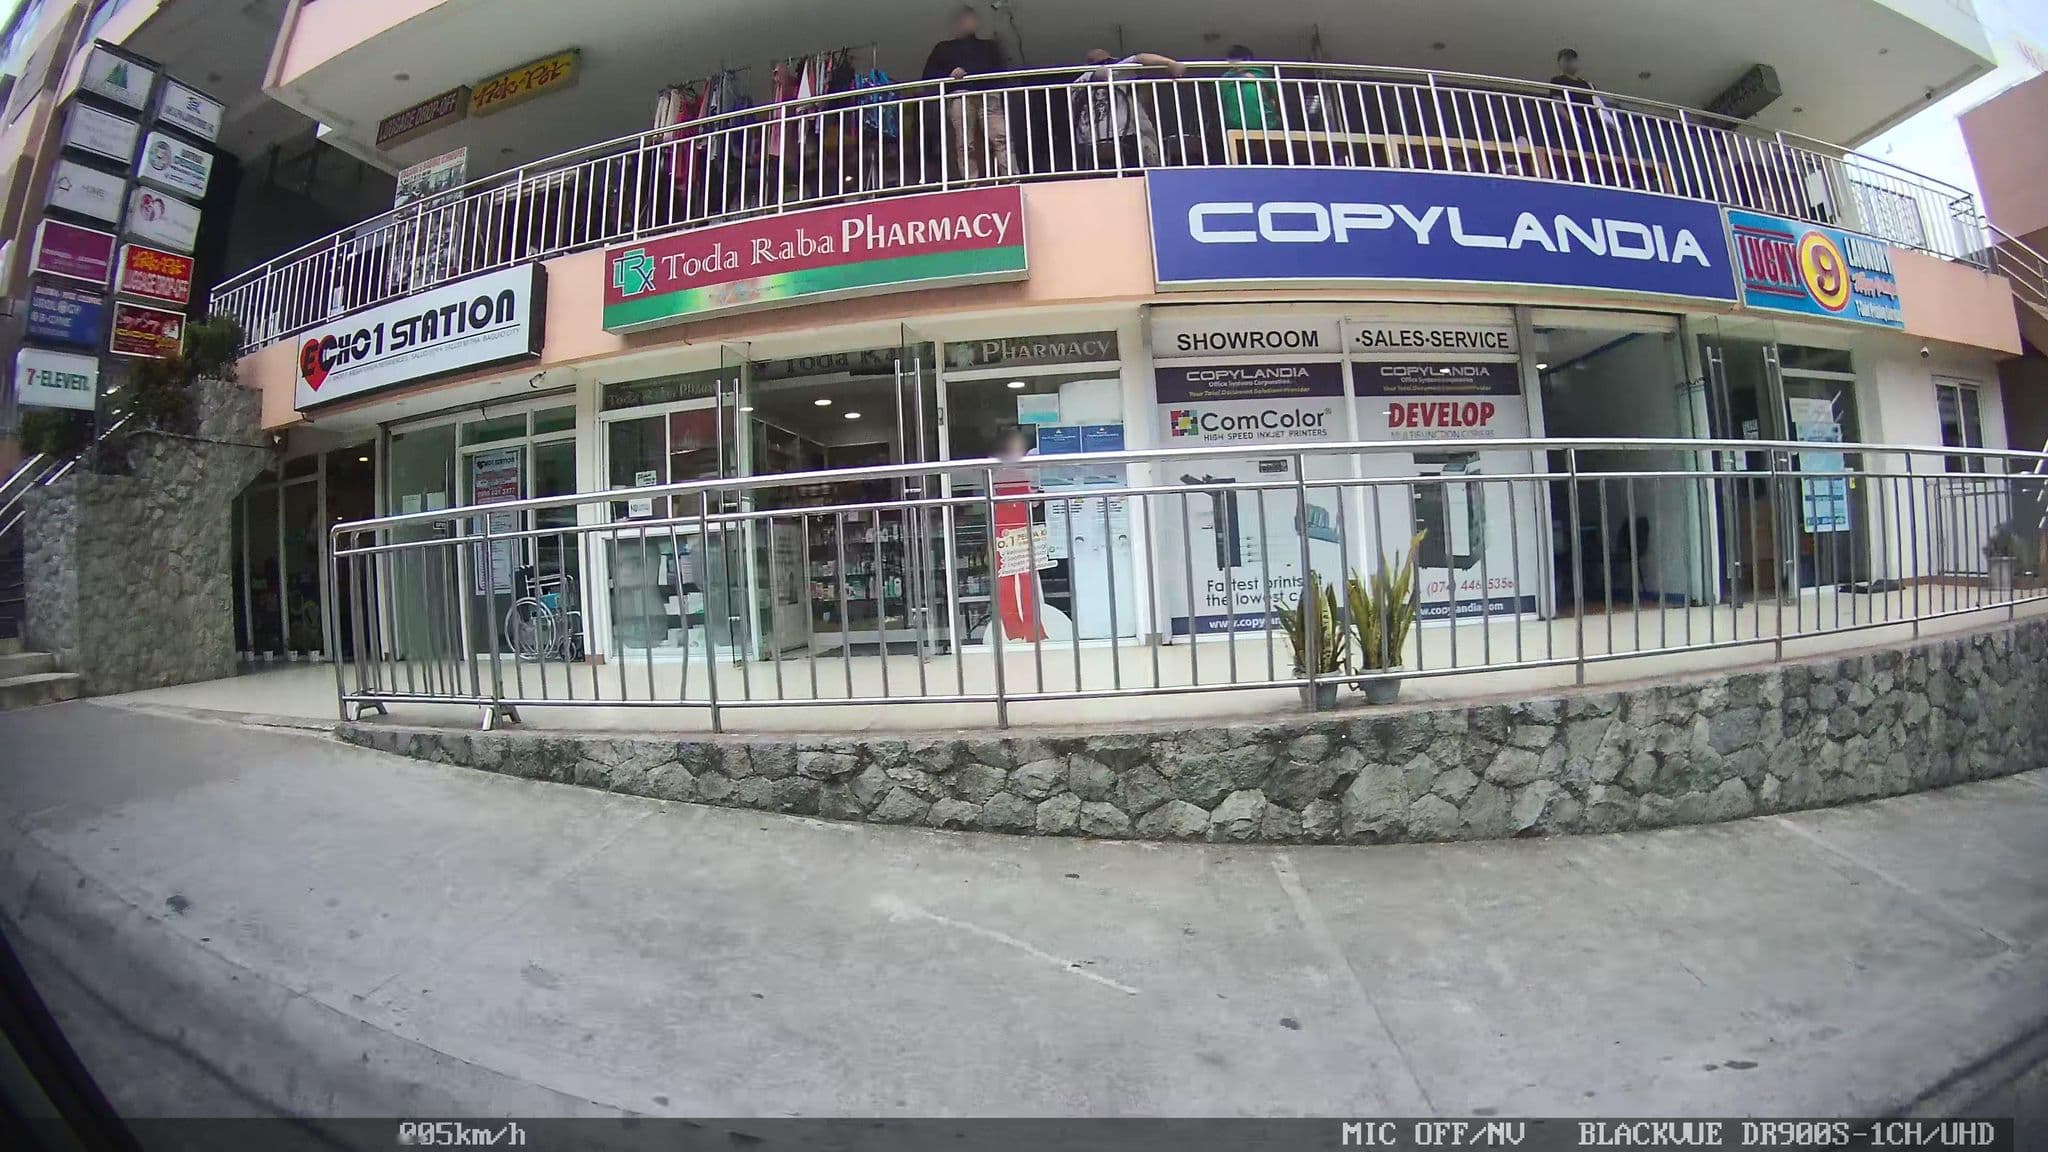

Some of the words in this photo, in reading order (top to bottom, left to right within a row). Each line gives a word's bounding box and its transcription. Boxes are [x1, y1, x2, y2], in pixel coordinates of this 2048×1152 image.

[1188, 201, 1712, 268] COPYLANDIA
[661, 241, 739, 281] Toda
[750, 228, 835, 266] Raba
[1734, 233, 1802, 288] LUCKY
[1810, 243, 1842, 297] 9
[374, 322, 384, 356] 1
[390, 288, 515, 349] STATION
[1177, 330, 1319, 351] SHOWROOM
[1430, 330, 1509, 349] SERVICE
[1186, 367, 1310, 381] COPYLANDIA
[1380, 366, 1490, 377] COPYLANDIA
[1200, 407, 1325, 432] ComColor
[1388, 401, 1495, 428] DEVELOP
[1227, 431, 1254, 440] SPEED
[1288, 428, 1328, 438] PRINTERS
[1207, 577, 1258, 593] Fatest
[1236, 589, 1284, 606] lowst
